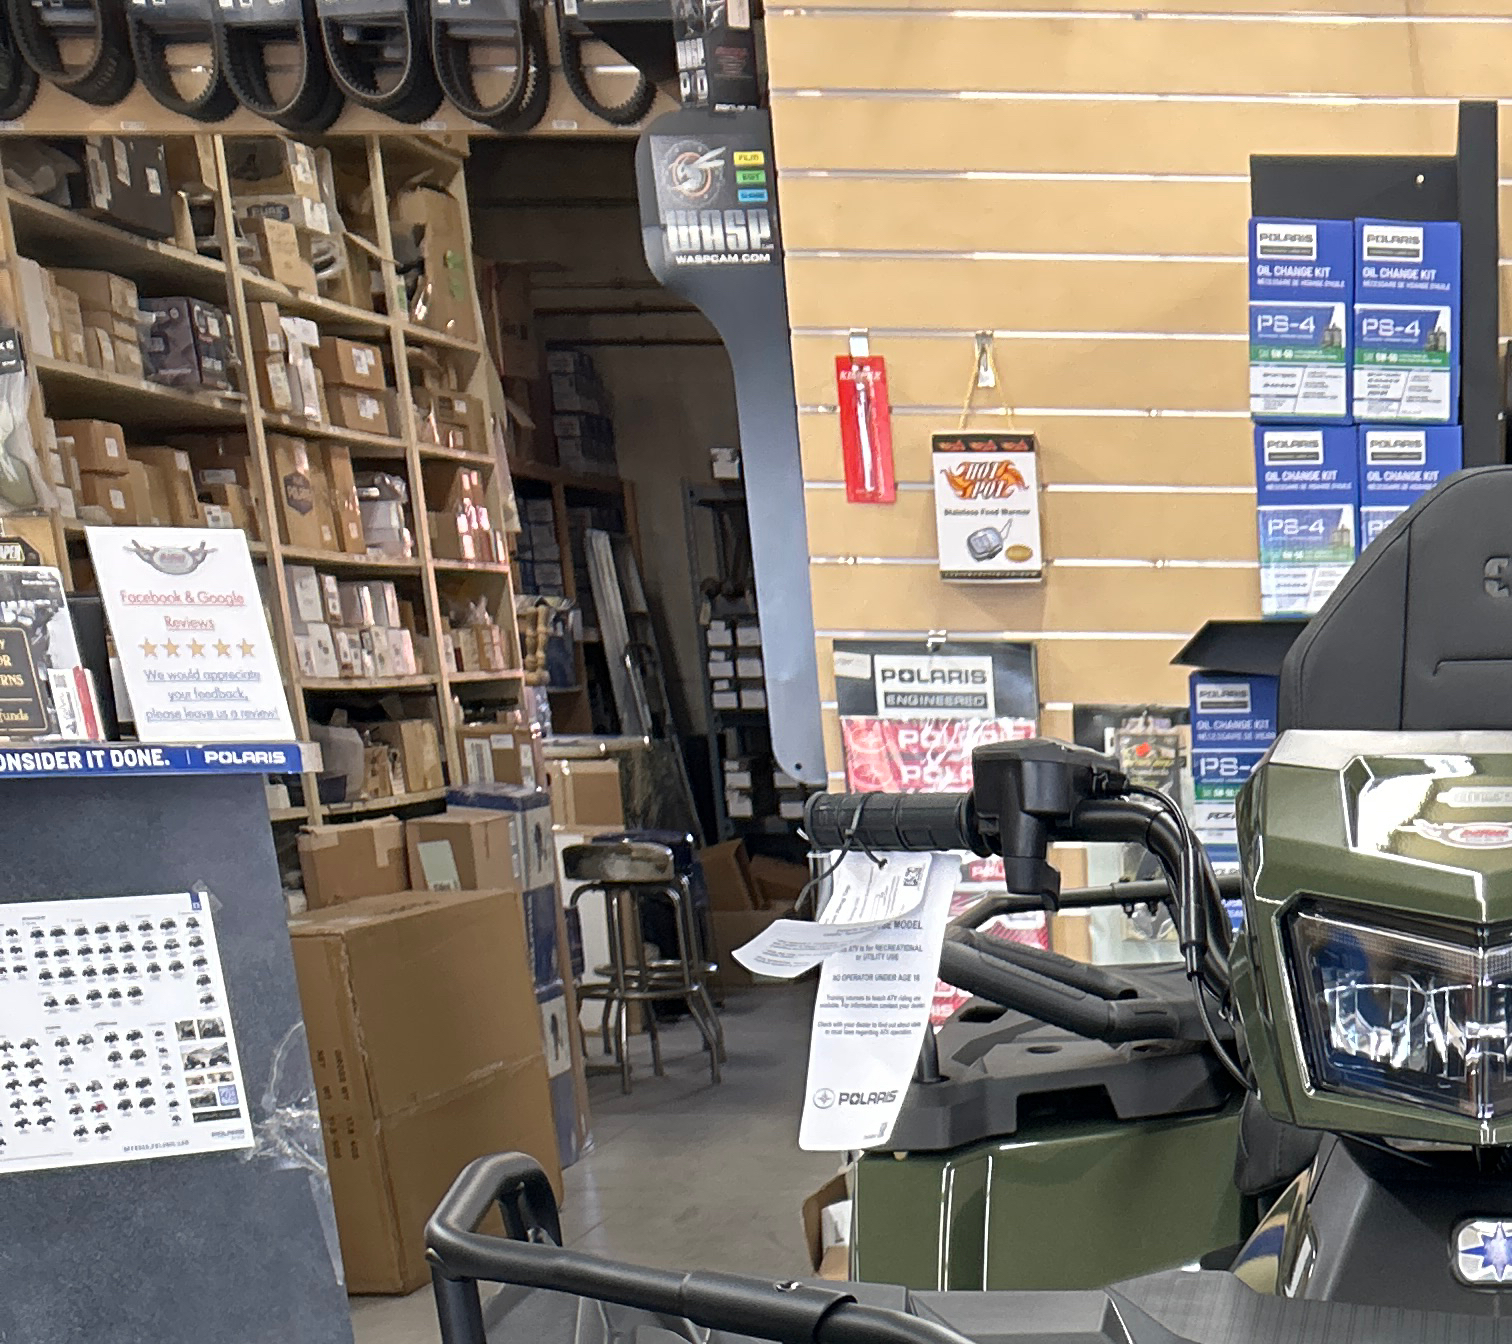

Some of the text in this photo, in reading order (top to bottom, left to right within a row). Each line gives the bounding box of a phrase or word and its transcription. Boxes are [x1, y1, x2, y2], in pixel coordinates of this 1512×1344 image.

[666, 208, 772, 251] WASP
[1260, 233, 1313, 243] POLARIS
[1367, 233, 1420, 244] POLARIS
[676, 253, 771, 264] WASPCAM.COM
[1257, 265, 1331, 279] OIL CHANGE KIT
[1362, 266, 1436, 281] OIL CHANGE KIT
[1283, 470, 1319, 482] CHANGE
[1322, 470, 1338, 481] KIT
[1384, 470, 1421, 482] CHANGE
[1423, 470, 1439, 481] KIT
[121, 590, 245, 607] Facebook & Google
[165, 616, 215, 629] Reviews
[144, 669, 261, 684] We would appreciate
[881, 668, 987, 684] POLARIS
[885, 693, 986, 707] ENGINEERED
[86, 750, 105, 769] IT
[110, 748, 170, 768] DONE.
[204, 750, 287, 764] POLARIS
[894, 920, 923, 930] MODEL
[842, 973, 874, 982] OPERATOR
[875, 973, 897, 982] UNDER
[838, 1089, 899, 1107] POLARIS
